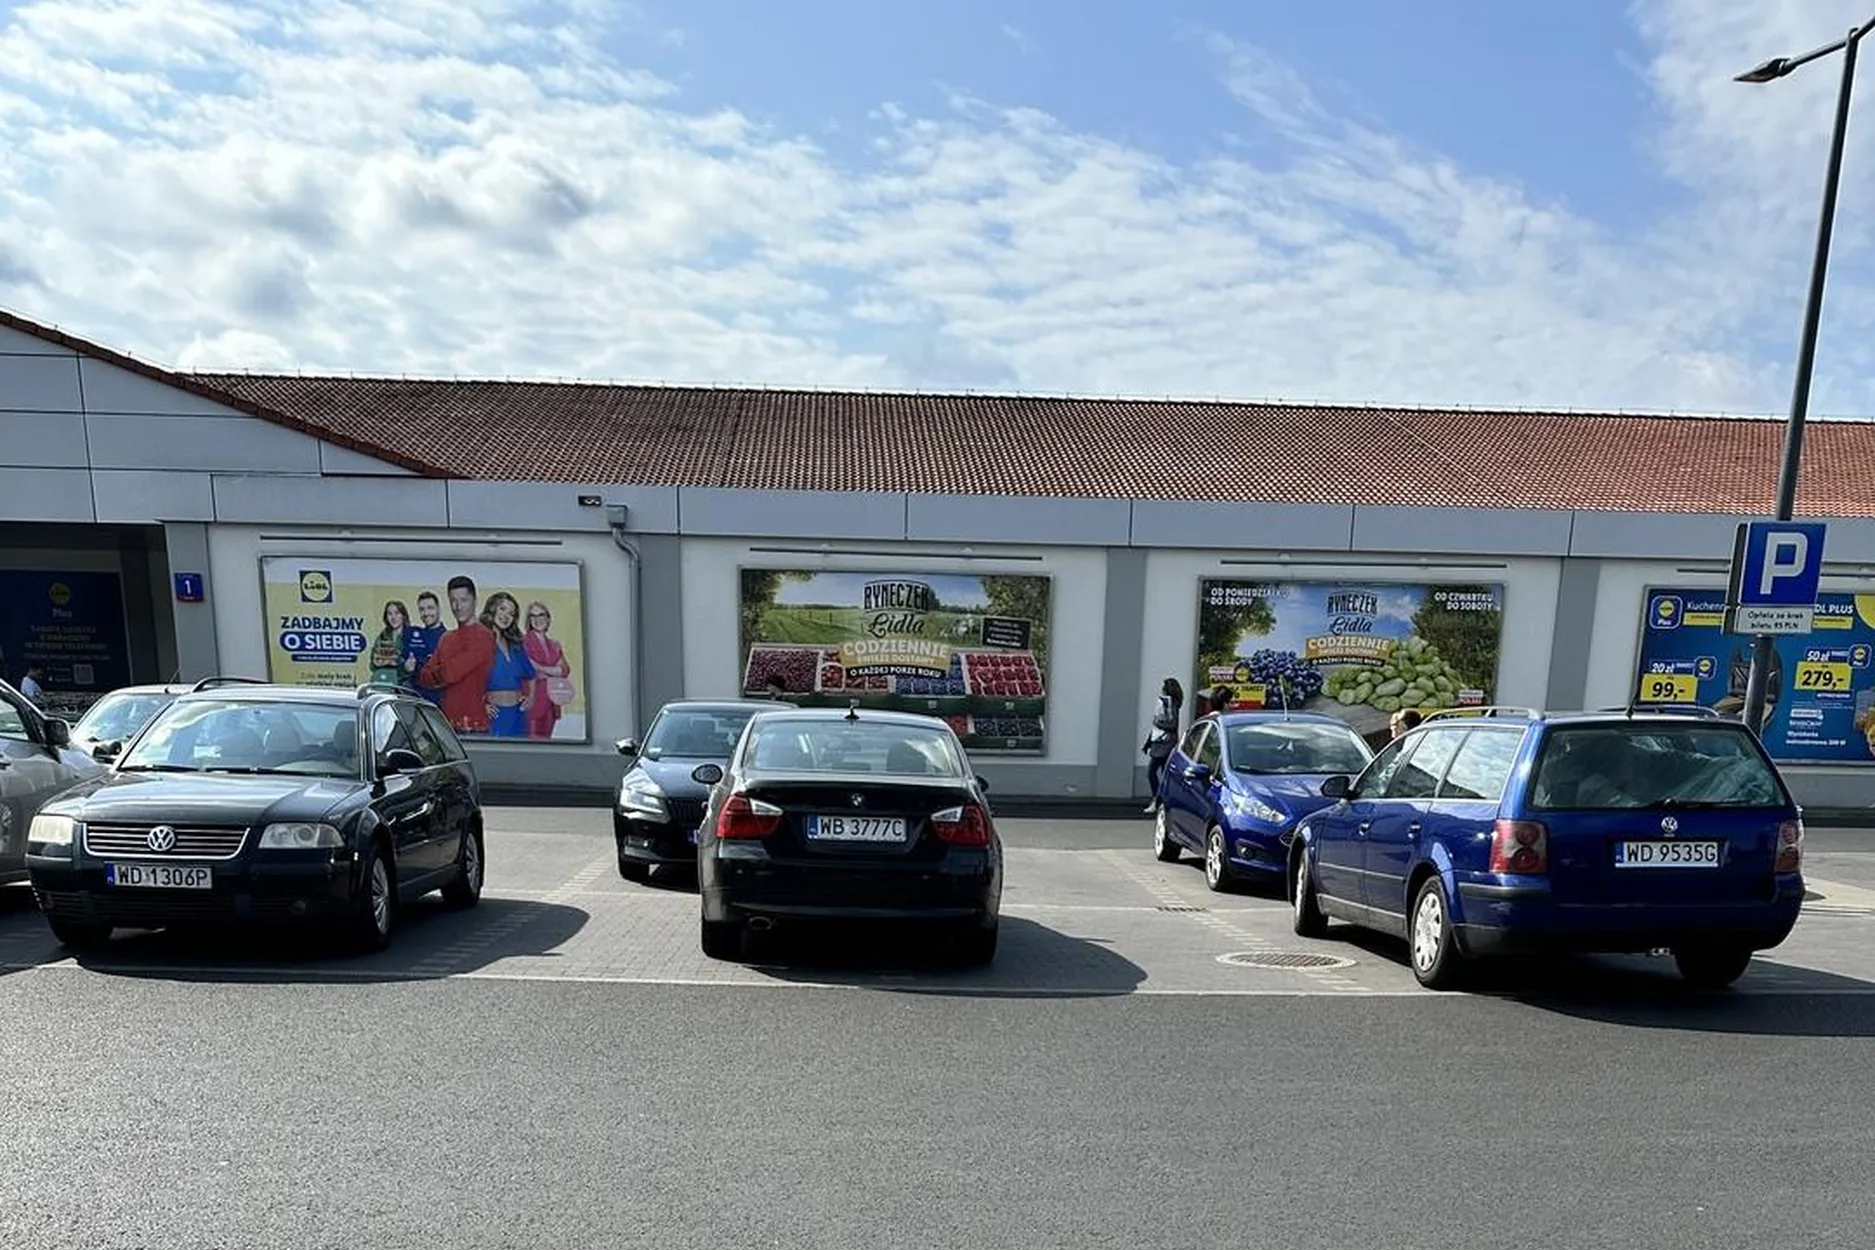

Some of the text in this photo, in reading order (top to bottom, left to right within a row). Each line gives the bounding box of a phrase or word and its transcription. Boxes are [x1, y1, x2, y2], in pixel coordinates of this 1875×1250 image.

[1760, 532, 1808, 595] P
[185, 580, 192, 595] 1
[1211, 587, 1224, 596] OD
[864, 583, 929, 611] RYNECZEK
[1434, 592, 1447, 601] OD
[1447, 602, 1459, 610] DO
[1828, 605, 1854, 614] PLUS
[280, 616, 364, 630] ZADBAJMY
[868, 612, 925, 638] Lidla
[1330, 616, 1373, 636] Lidla
[284, 633, 362, 650] O SIEBIE
[843, 639, 950, 658] CODZIENNIE
[1308, 636, 1390, 651] CODZIENNIE
[1807, 650, 1820, 661] 50
[1652, 662, 1665, 673] 20
[1802, 670, 1845, 689] 279,-
[1652, 682, 1686, 700] 99,-
[820, 818, 902, 836] WB 3777C
[1627, 844, 1716, 862] WD 9535G
[118, 865, 208, 886] WD 1306P
